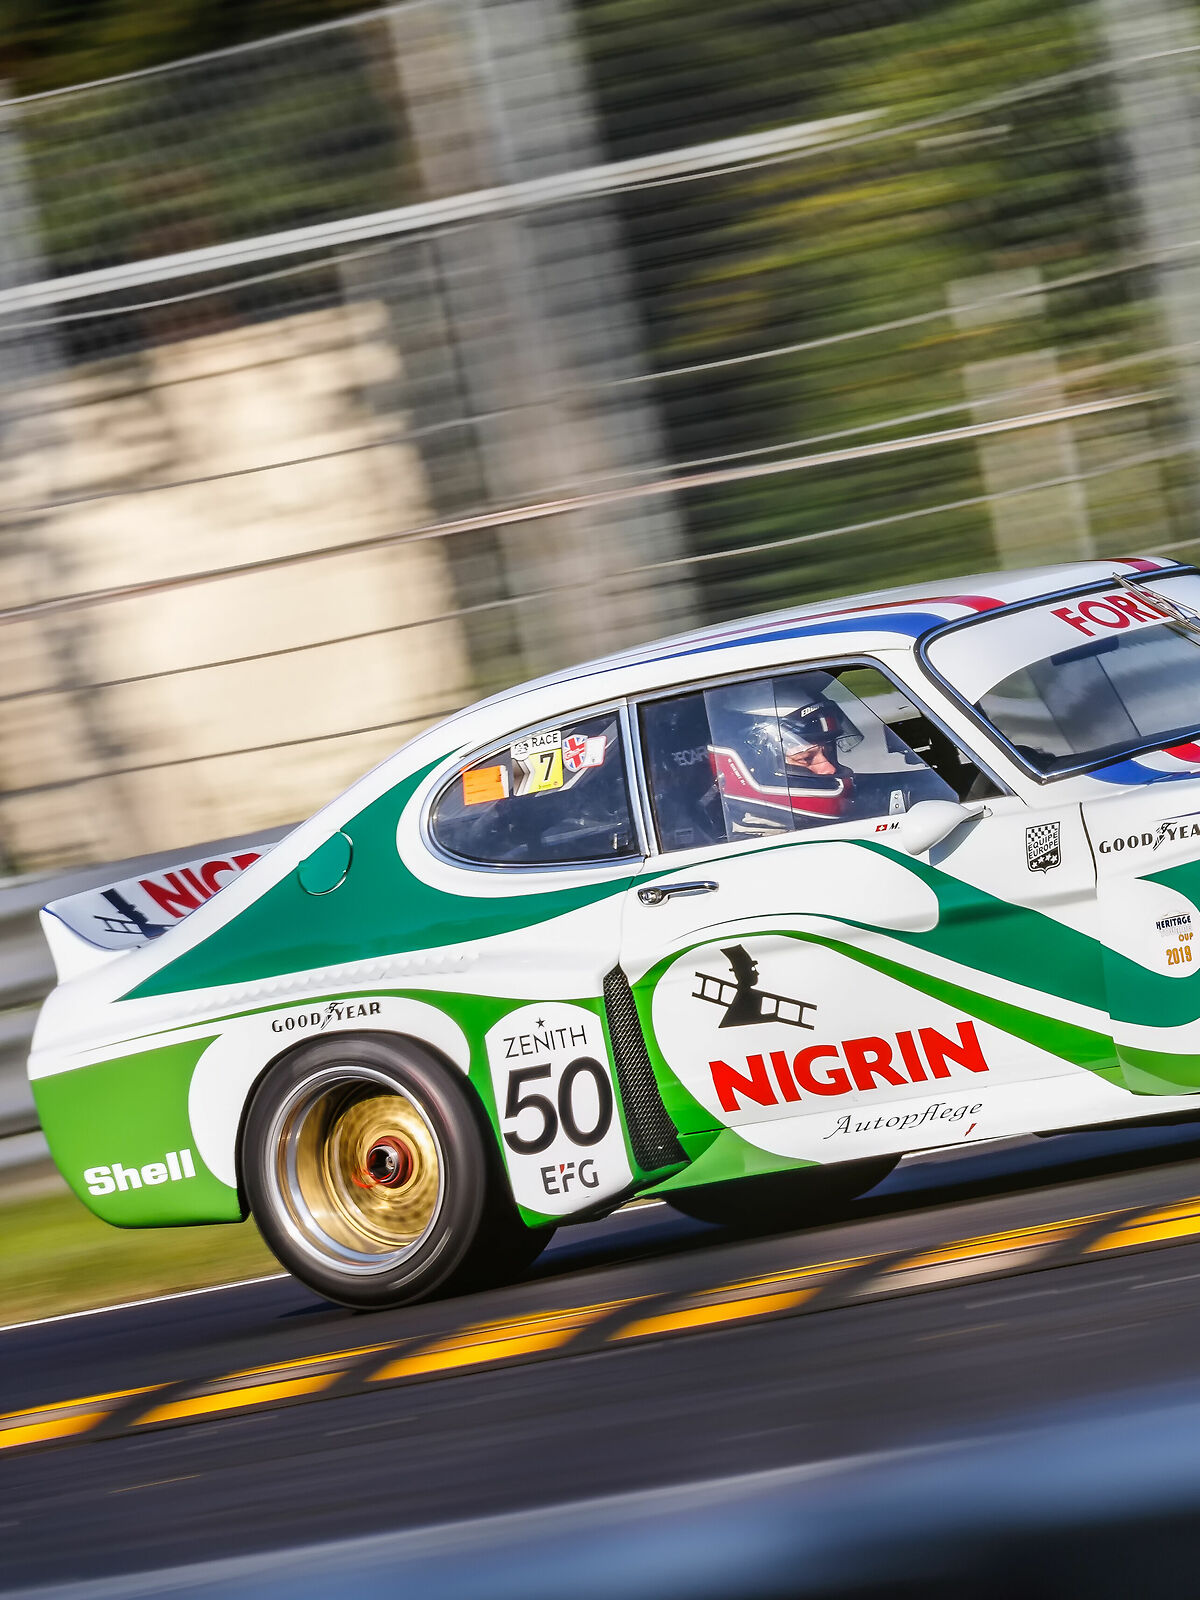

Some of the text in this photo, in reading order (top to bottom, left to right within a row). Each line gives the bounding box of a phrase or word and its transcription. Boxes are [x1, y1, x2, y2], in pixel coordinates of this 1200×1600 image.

[531, 732, 559, 748] RACE
[539, 751, 555, 781] 7
[1027, 830, 1059, 852] EQUIPE
[1028, 838, 1059, 860] EUROPE
[138, 852, 263, 919] NIG
[1155, 915, 1192, 931] HERITAGE
[1165, 945, 1193, 966] 2019
[503, 1024, 588, 1059] ZENITH
[708, 1020, 990, 1113] NIGRIN
[503, 1055, 613, 1156] 50
[822, 1101, 984, 1140] Autopflege
[83, 1148, 197, 1196] Shell
[540, 1158, 600, 1196] EFG
